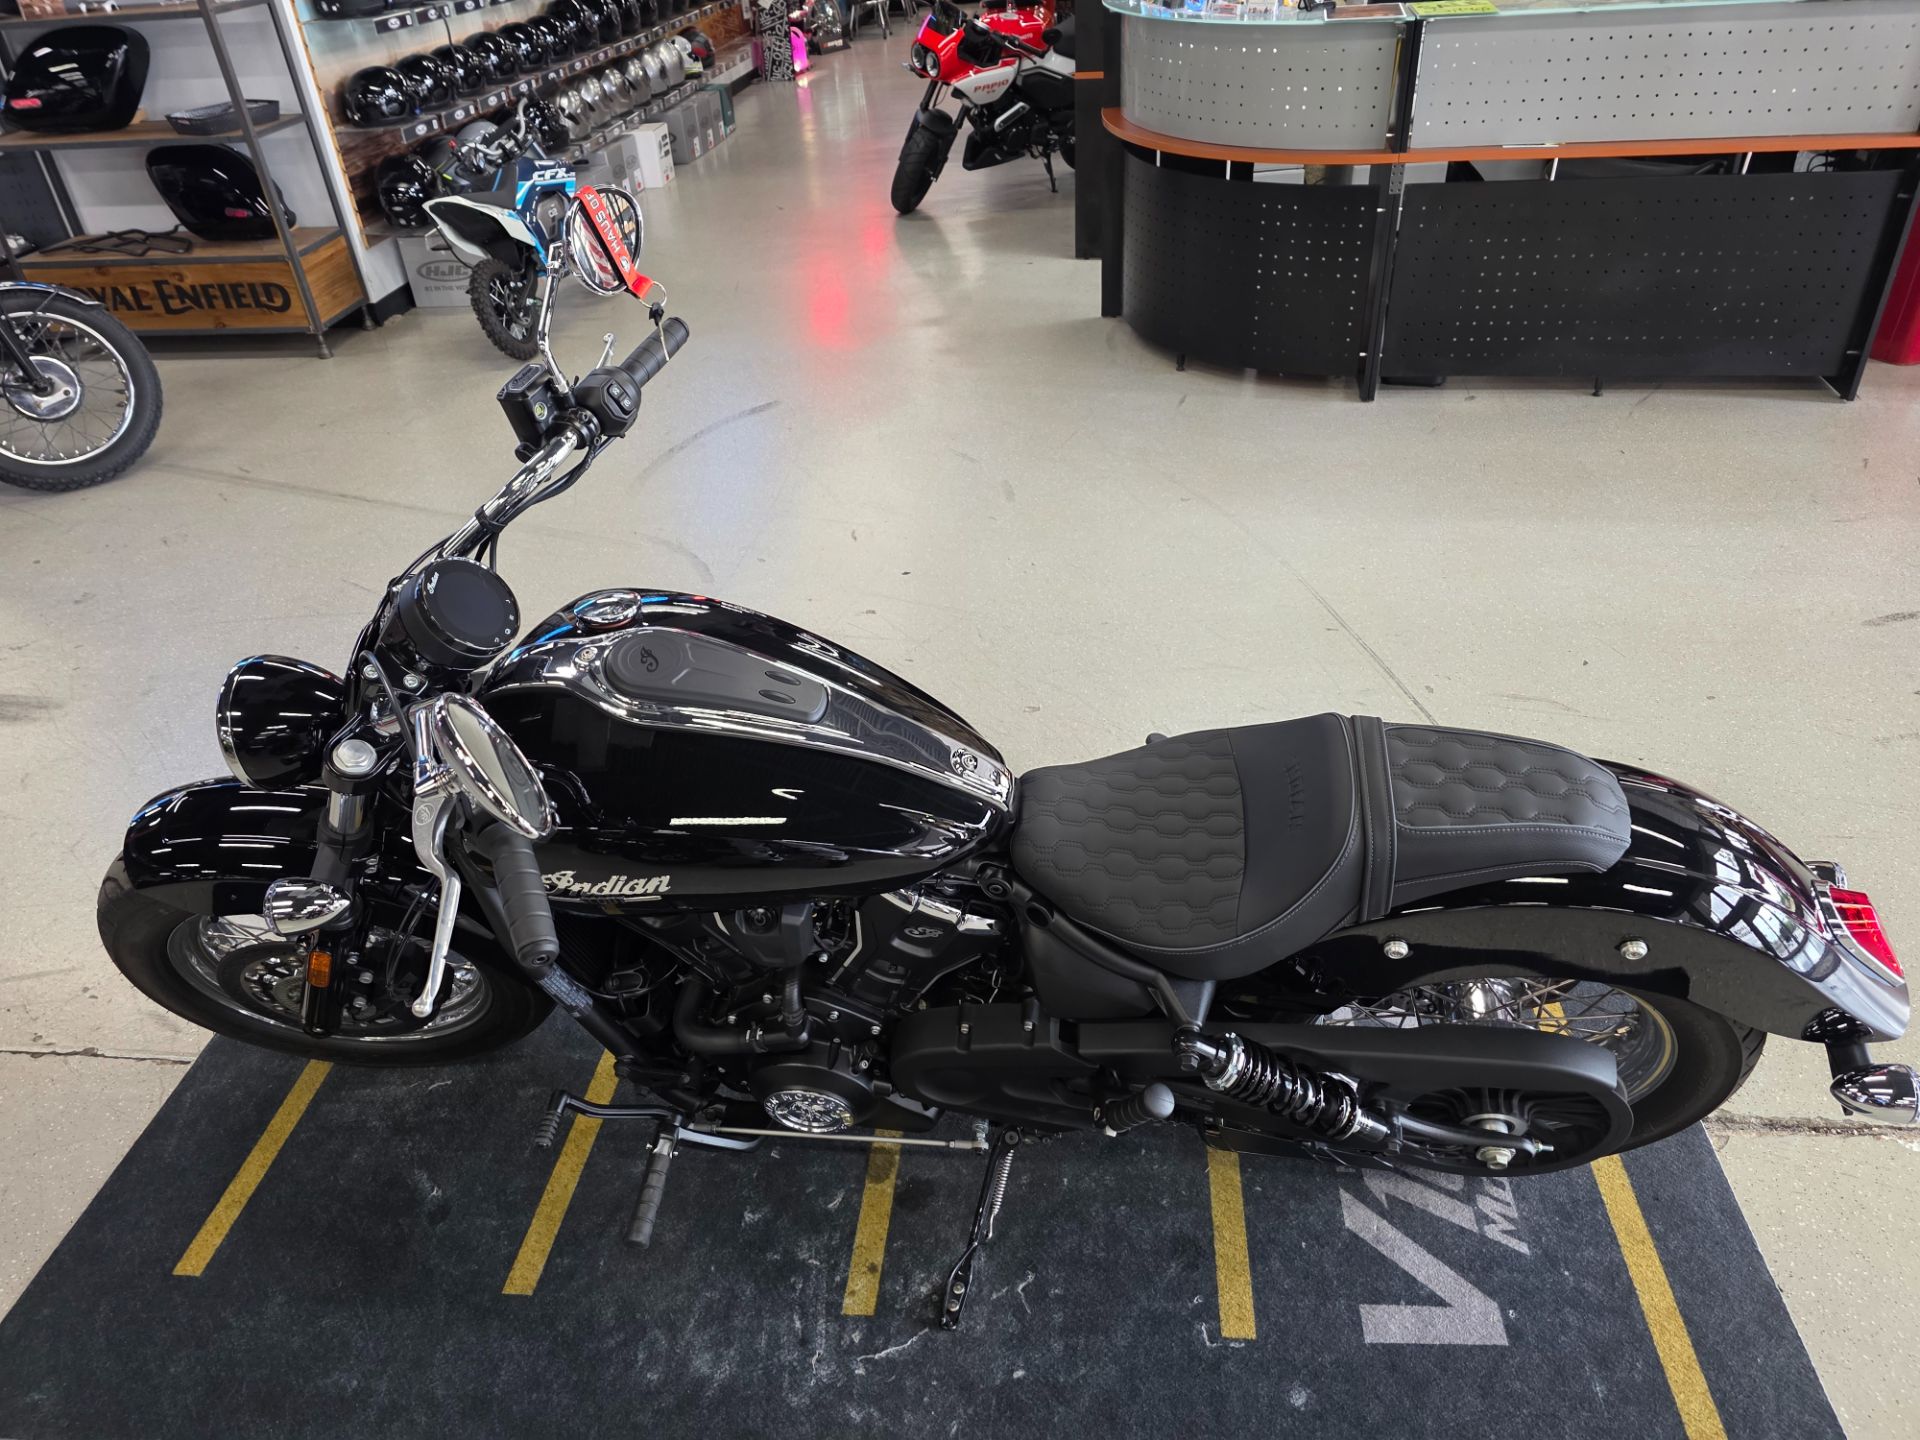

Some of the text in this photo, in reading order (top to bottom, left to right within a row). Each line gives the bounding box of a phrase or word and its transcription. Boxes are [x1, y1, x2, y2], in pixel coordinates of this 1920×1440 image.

[584, 192, 622, 254] HAUS OF
[426, 264, 469, 277] HJC
[152, 280, 292, 315] ENFIELD
[541, 870, 671, 897] Indian
